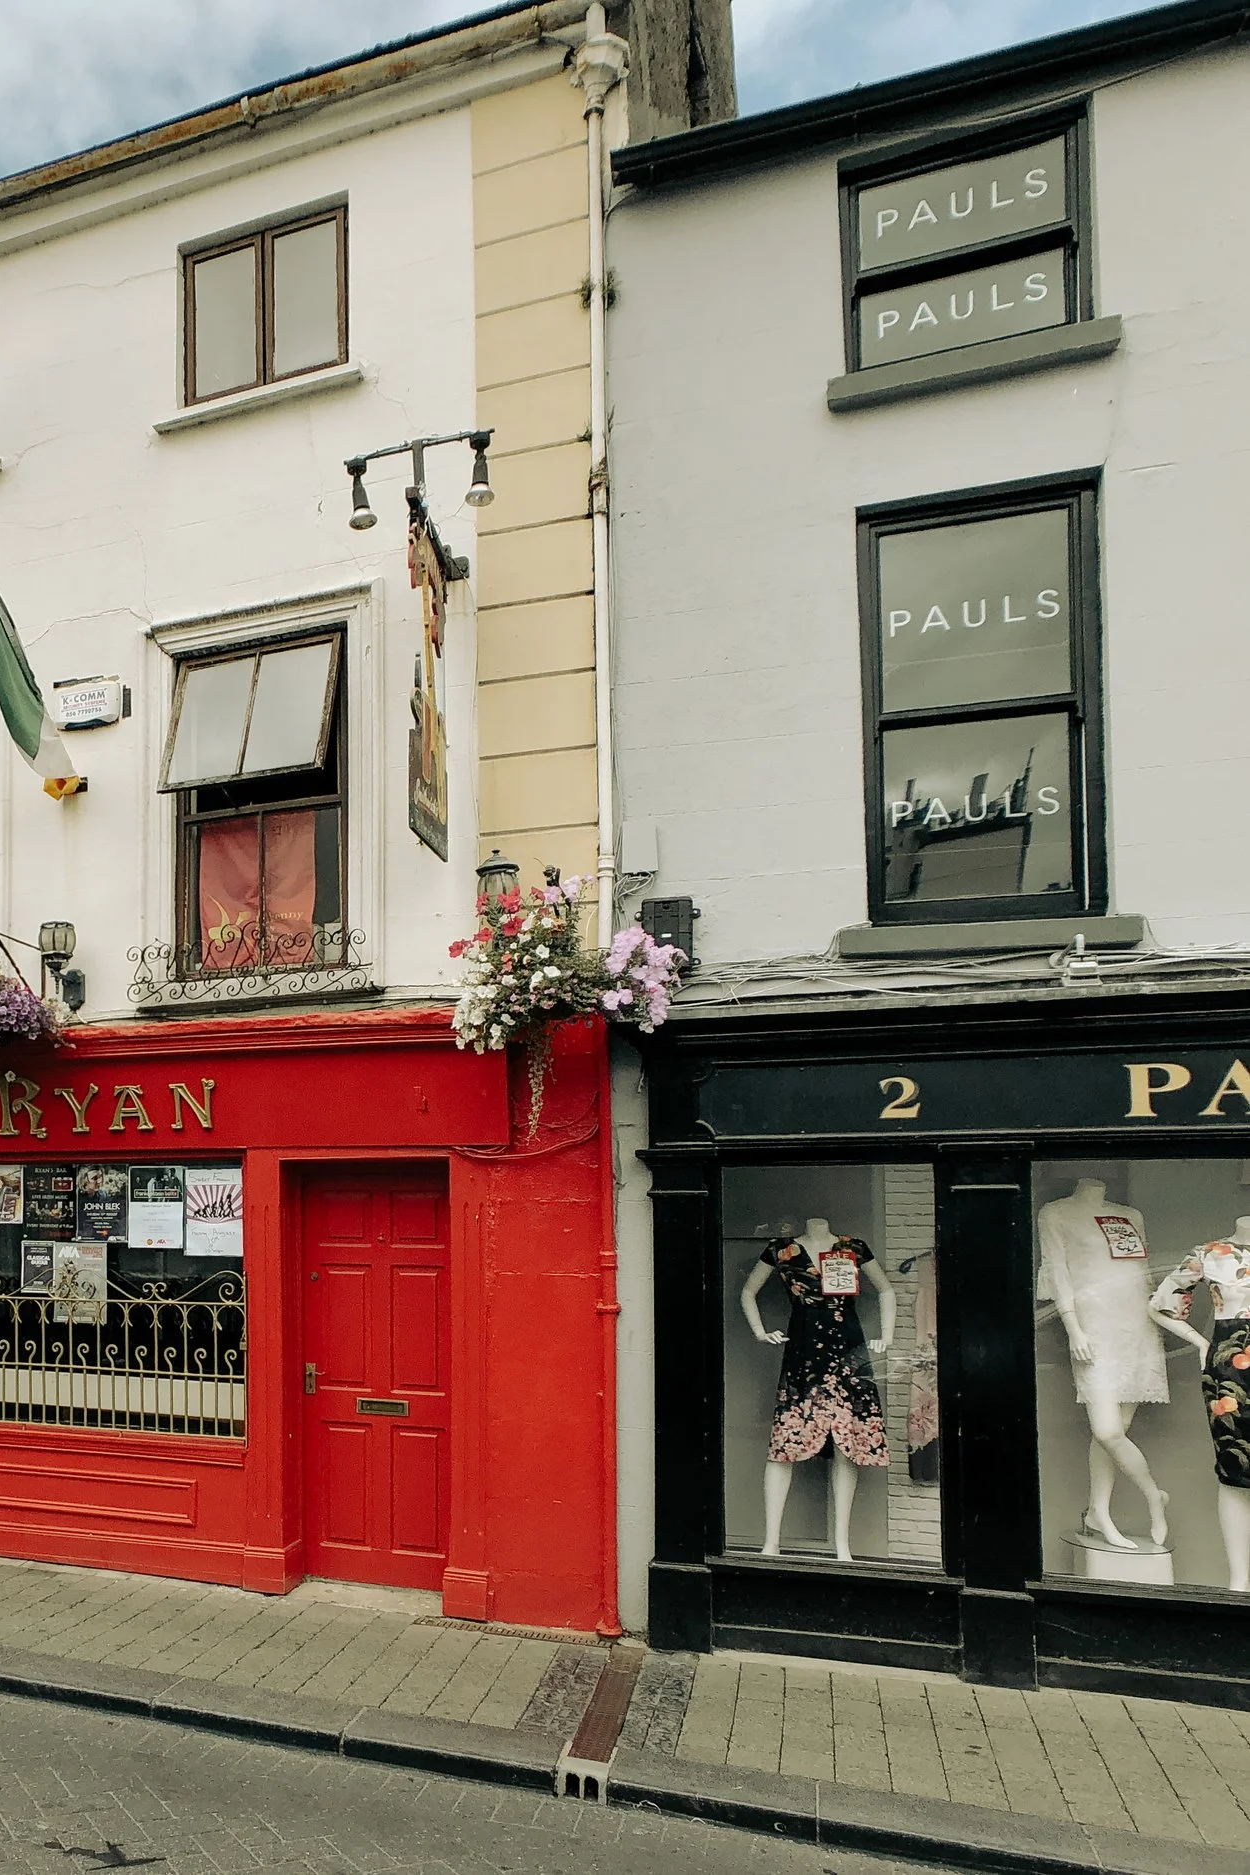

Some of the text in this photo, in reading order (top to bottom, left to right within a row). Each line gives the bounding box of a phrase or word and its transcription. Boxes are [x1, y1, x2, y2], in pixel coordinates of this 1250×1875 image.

[876, 168, 1049, 238] PAULS
[877, 272, 1049, 339] PAULS
[889, 589, 1061, 637] PAULS
[62, 691, 106, 705] K-COMM
[891, 786, 1061, 828] PAULS
[878, 1058, 1250, 1119] 2 PA
[83, 1202, 121, 1211] JOHN BLEK
[825, 1252, 850, 1260] SALE
